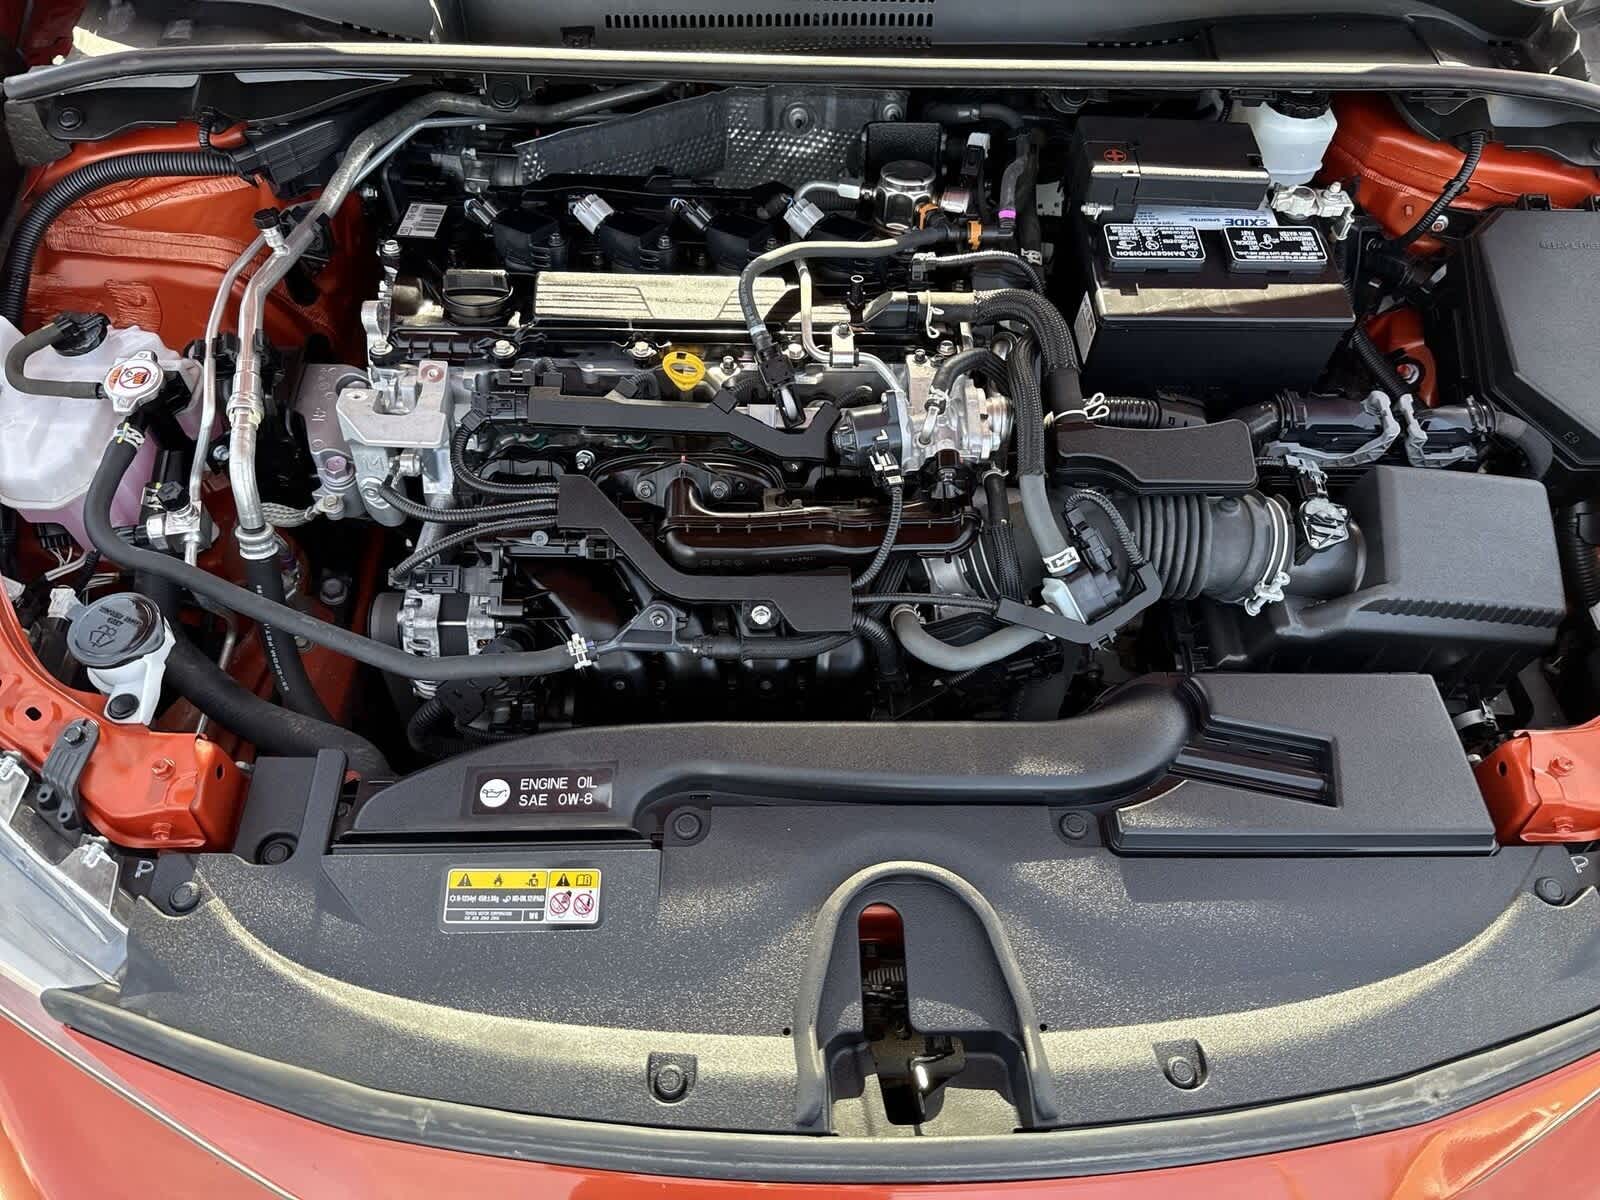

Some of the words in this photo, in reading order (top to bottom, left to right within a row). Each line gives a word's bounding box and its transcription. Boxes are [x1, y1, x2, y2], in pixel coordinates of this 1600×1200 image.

[1224, 218, 1269, 227] EXIDE
[520, 776, 568, 790] ENGINE
[577, 776, 597, 789] OIL
[519, 794, 548, 806] SAE
[558, 792, 593, 805] 0W-8
